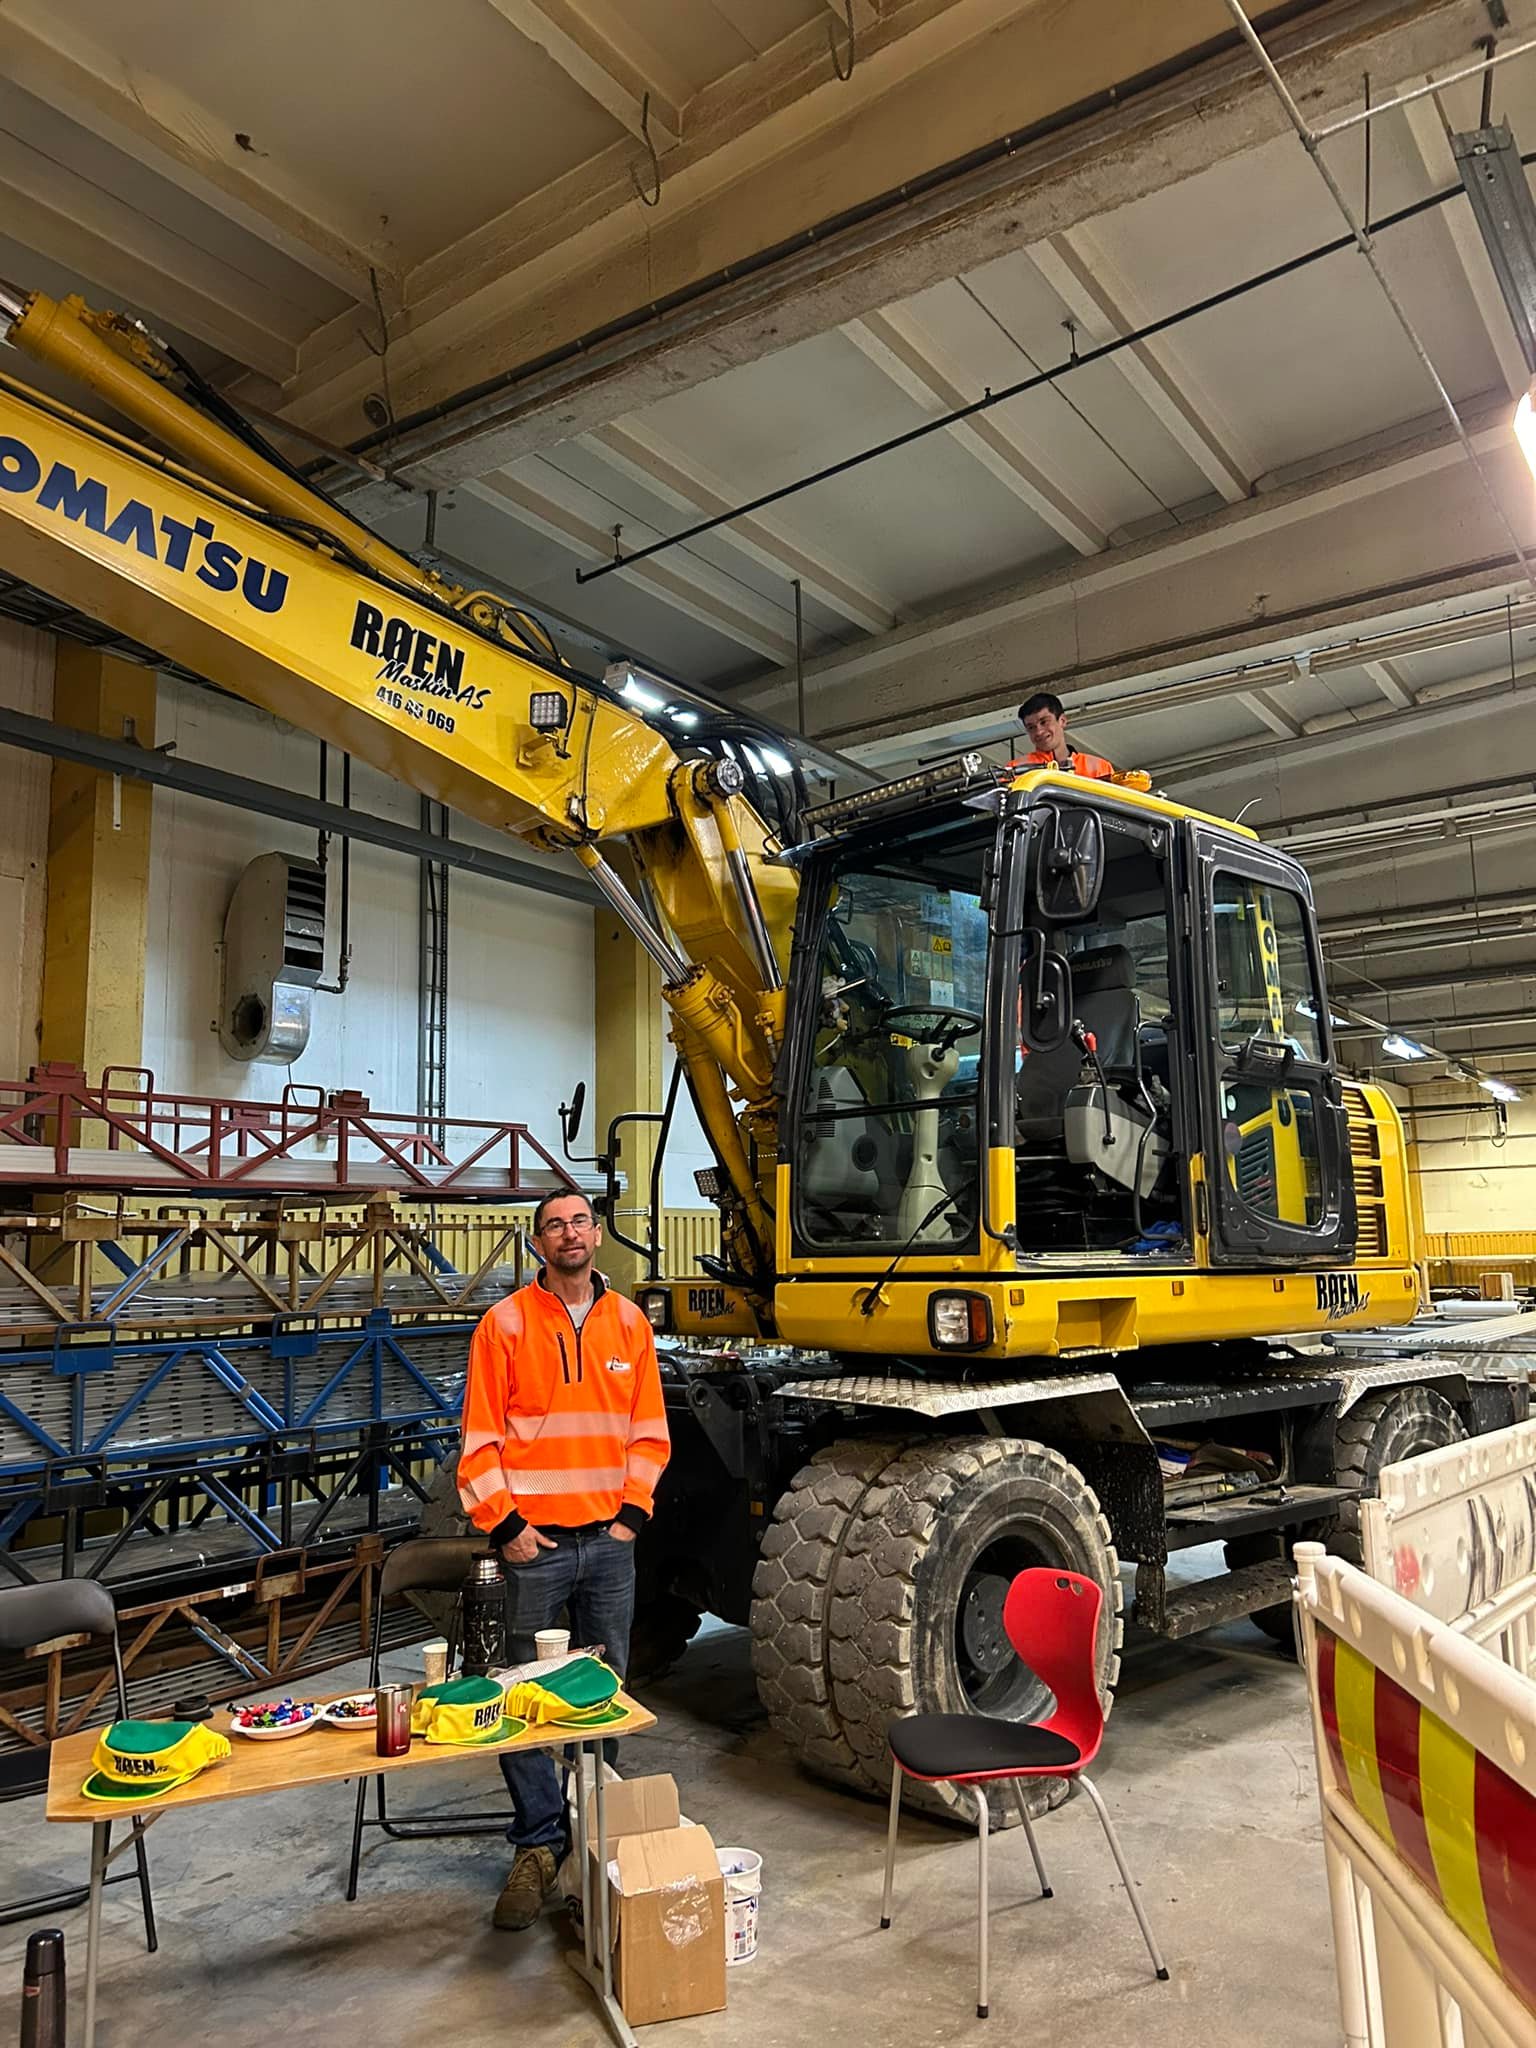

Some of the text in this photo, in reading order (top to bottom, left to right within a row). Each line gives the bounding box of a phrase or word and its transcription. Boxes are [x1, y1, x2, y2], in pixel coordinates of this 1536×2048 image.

[350, 599, 465, 696] RØEN
[376, 660, 492, 709] Maskin AS
[376, 686, 403, 709] 416
[427, 708, 455, 733] 069
